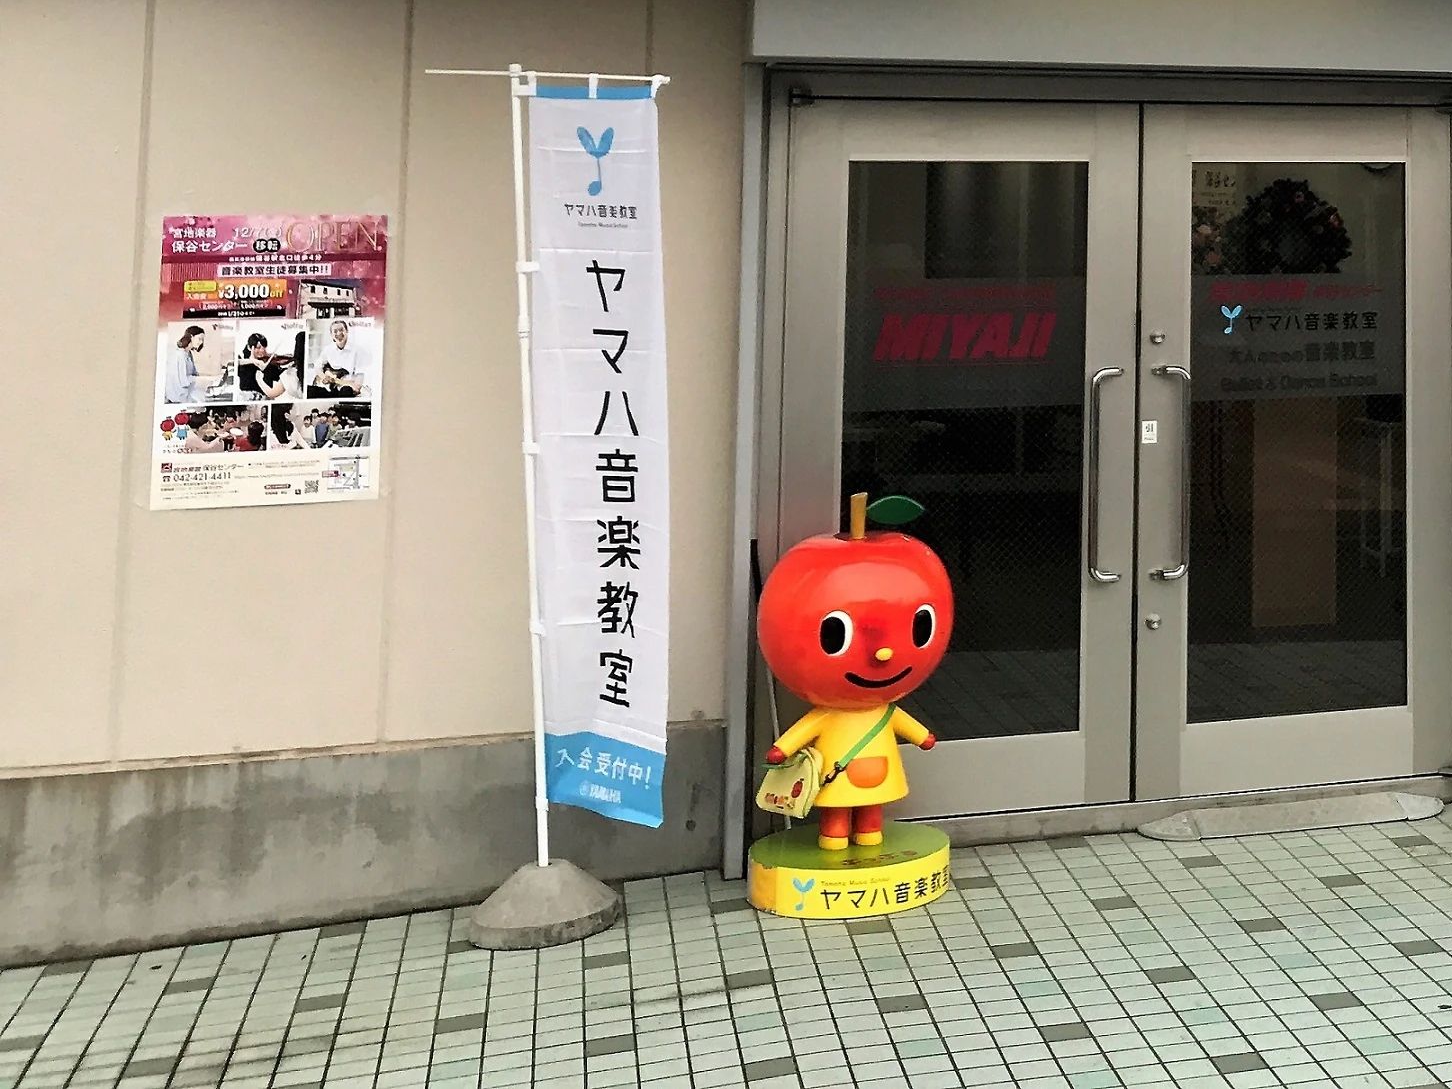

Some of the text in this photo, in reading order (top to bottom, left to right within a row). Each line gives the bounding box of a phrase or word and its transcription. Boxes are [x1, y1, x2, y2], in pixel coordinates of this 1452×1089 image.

[564, 203, 638, 220] ヤマハ音楽教室
[872, 311, 1057, 361] MIYAJI
[1246, 311, 1378, 331] ヤマハ音楽教室
[586, 258, 642, 708] ヤマハ音楽教室
[555, 746, 652, 790] 入会受付中!
